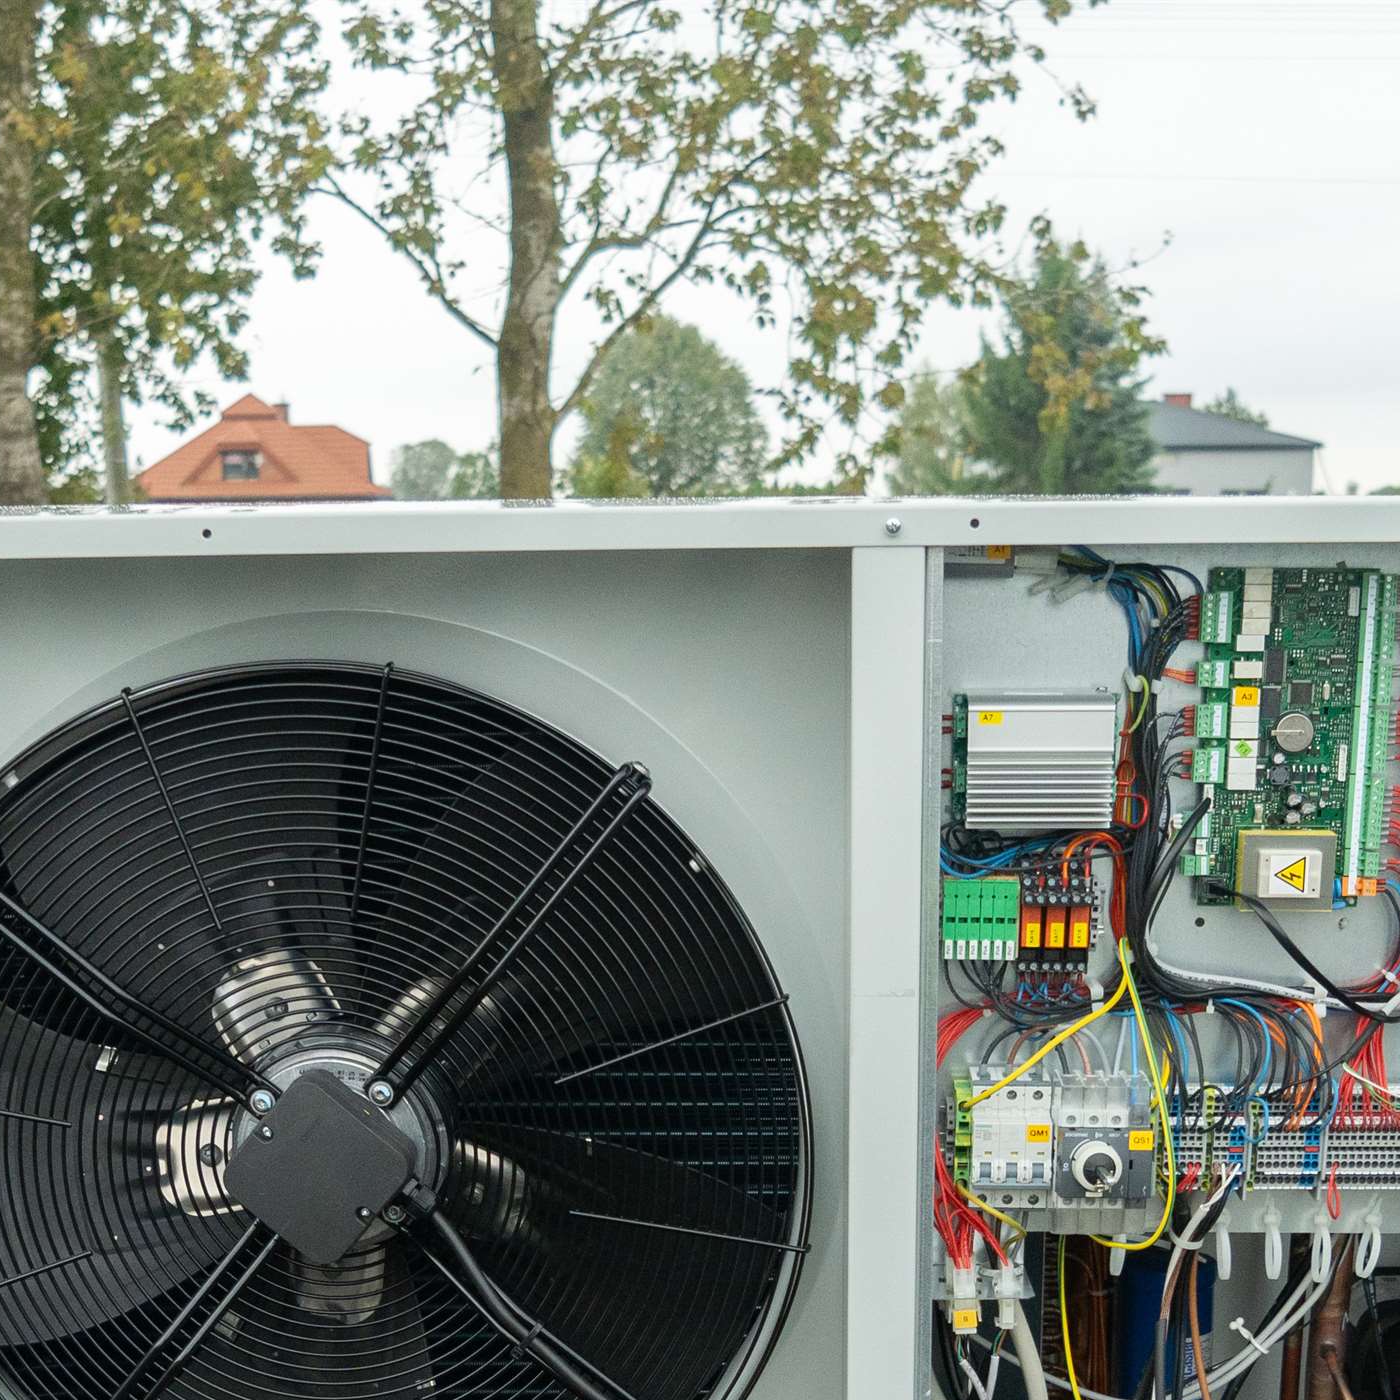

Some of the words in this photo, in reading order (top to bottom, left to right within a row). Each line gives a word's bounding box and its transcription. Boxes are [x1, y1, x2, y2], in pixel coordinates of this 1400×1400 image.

[982, 713, 993, 721] A7
[1029, 1129, 1049, 1137] QM1
[1133, 1136, 1150, 1144] QS1
